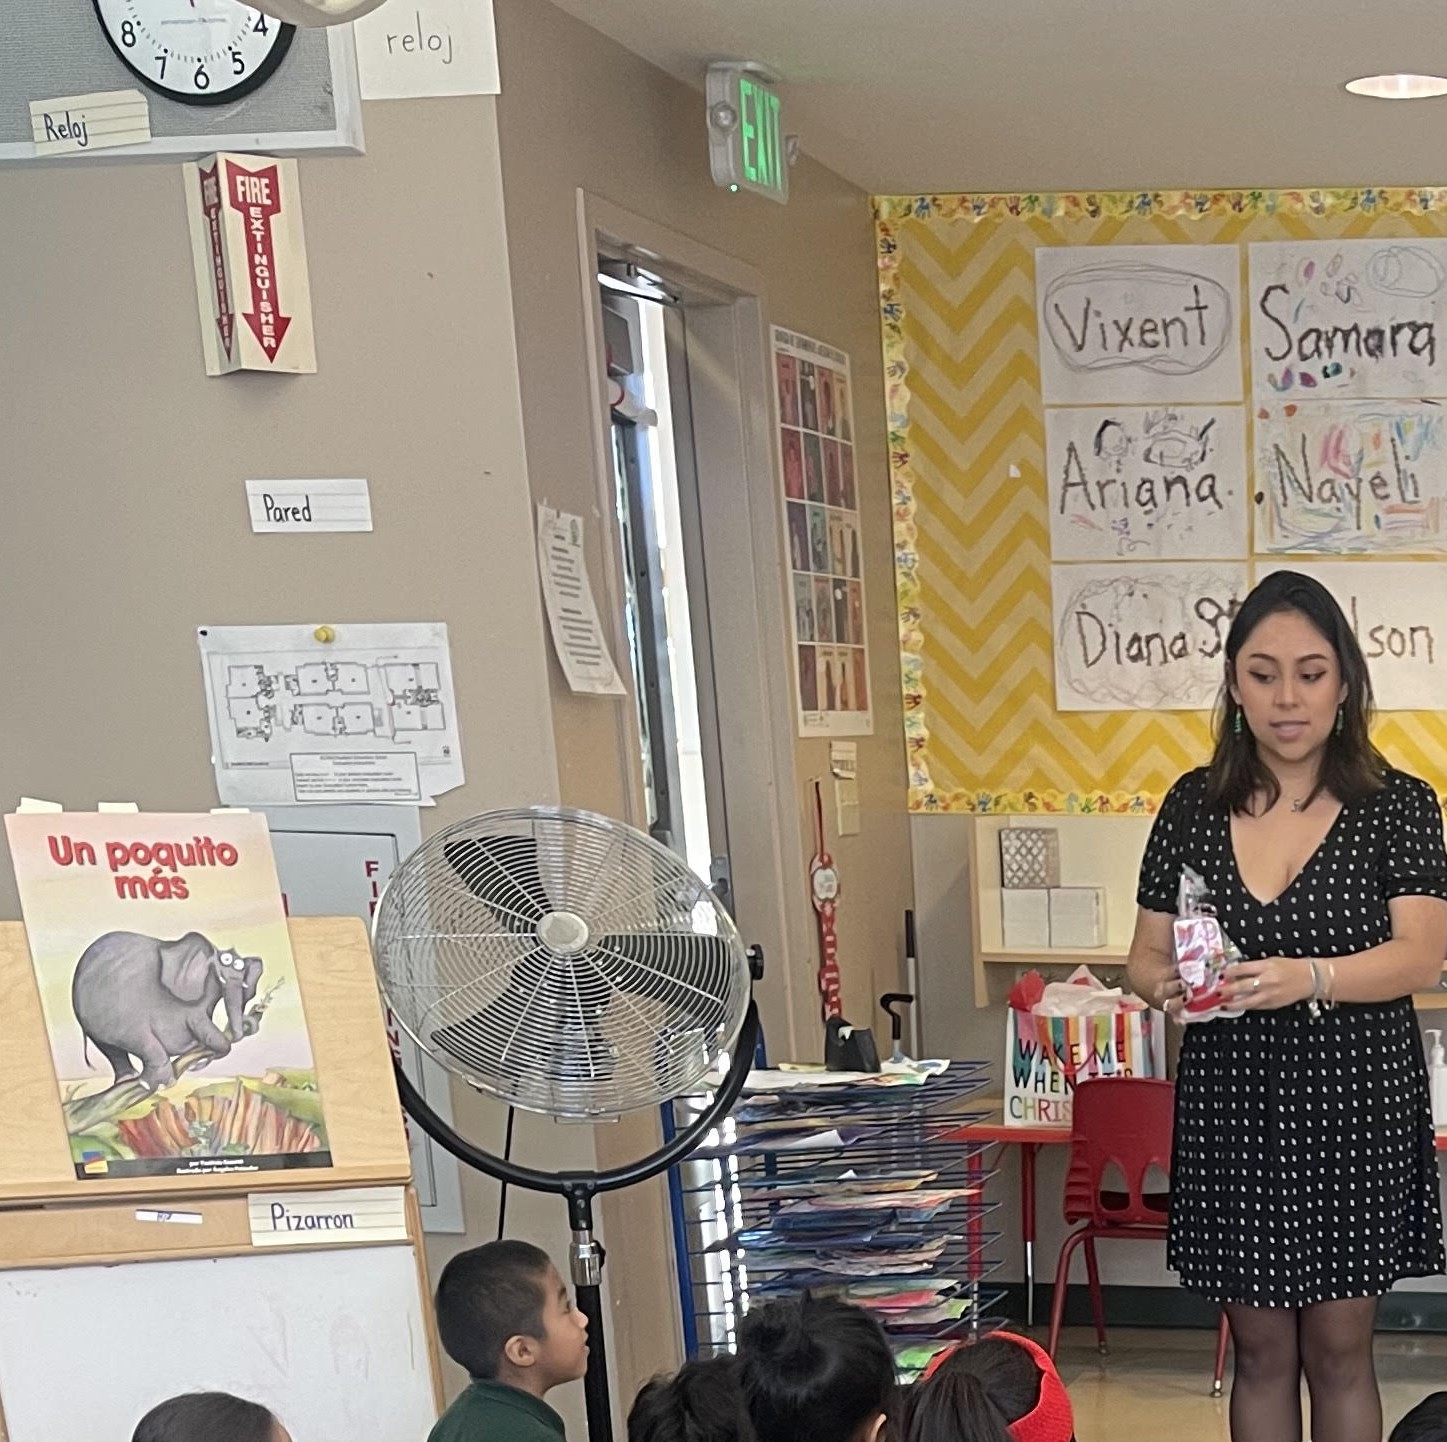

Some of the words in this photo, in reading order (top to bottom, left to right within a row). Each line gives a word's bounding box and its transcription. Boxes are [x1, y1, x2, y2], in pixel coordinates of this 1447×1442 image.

[121, 20, 136, 48] 8
[253, 13, 269, 37] 4
[386, 11, 454, 65] reloj
[155, 56, 167, 80] 7
[194, 64, 210, 90] 6
[231, 51, 245, 75] 5
[44, 111, 89, 147] Reloj
[235, 175, 272, 206] FIRE
[249, 206, 277, 349] EXTINGUISHER
[1054, 285, 1209, 353] Vixent
[1260, 283, 1436, 366] Samara
[1273, 433, 1421, 530] Nayeli
[263, 494, 312, 523] Pared
[1075, 610, 1189, 667] Diana
[47, 836, 96, 867] Un
[106, 836, 238, 872] poquito
[115, 868, 190, 900] más
[1018, 1038, 1082, 1066] WAKE
[1093, 1039, 1126, 1065] ME
[1012, 1065, 1077, 1096] WHEN
[1010, 1095, 1072, 1122] CHRIS
[270, 1202, 355, 1231] Pizarron
